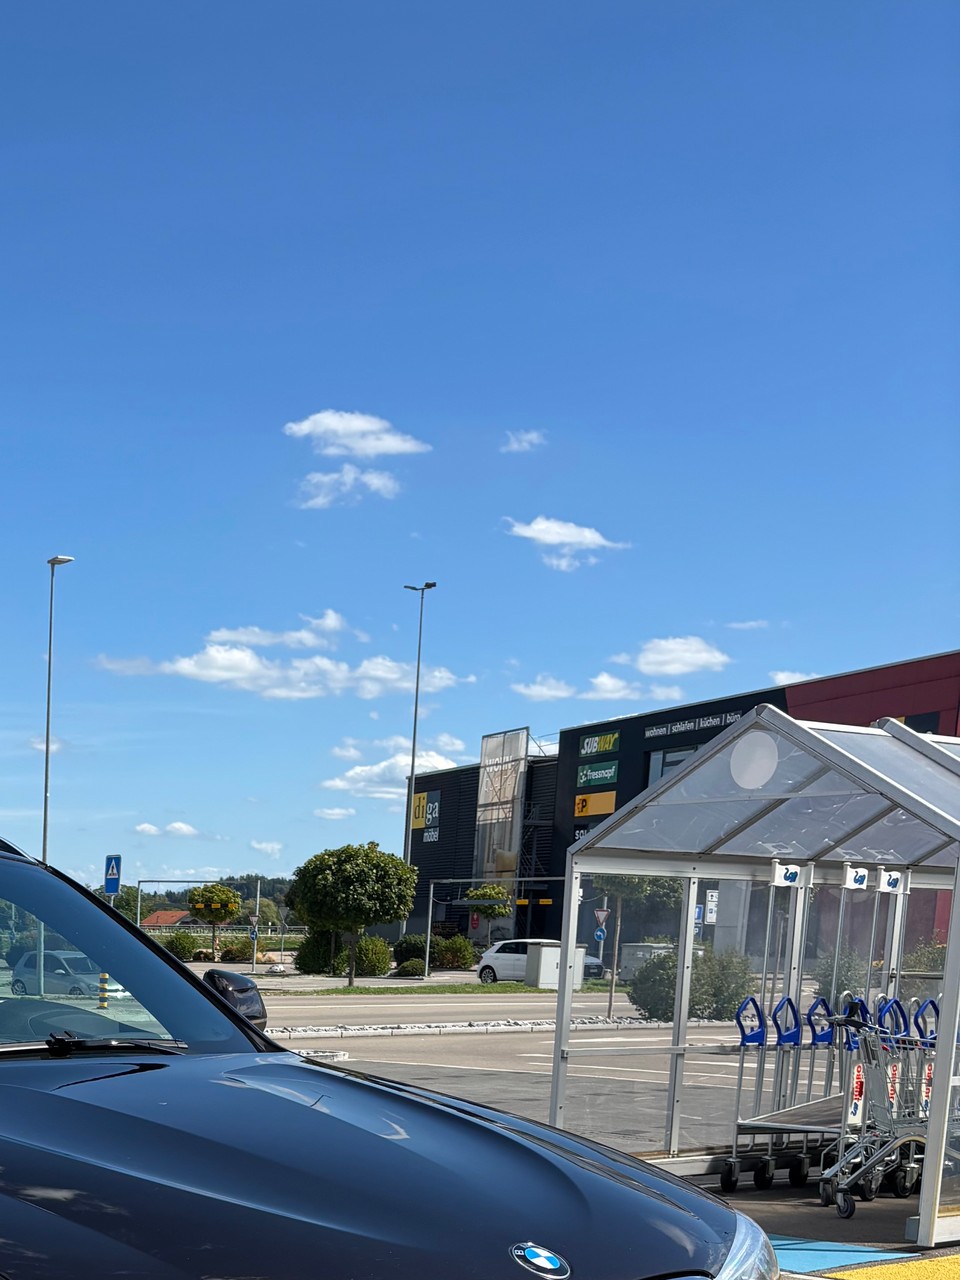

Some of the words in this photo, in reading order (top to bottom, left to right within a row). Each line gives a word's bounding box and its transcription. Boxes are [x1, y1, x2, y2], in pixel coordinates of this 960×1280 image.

[645, 727, 666, 737] wohnen
[671, 721, 694, 733] schlafen
[700, 716, 720, 728] küchen
[581, 732, 619, 754] SUBWAY
[587, 766, 616, 780] fressnapf
[414, 796, 439, 825] diga
[423, 828, 439, 842] möbel
